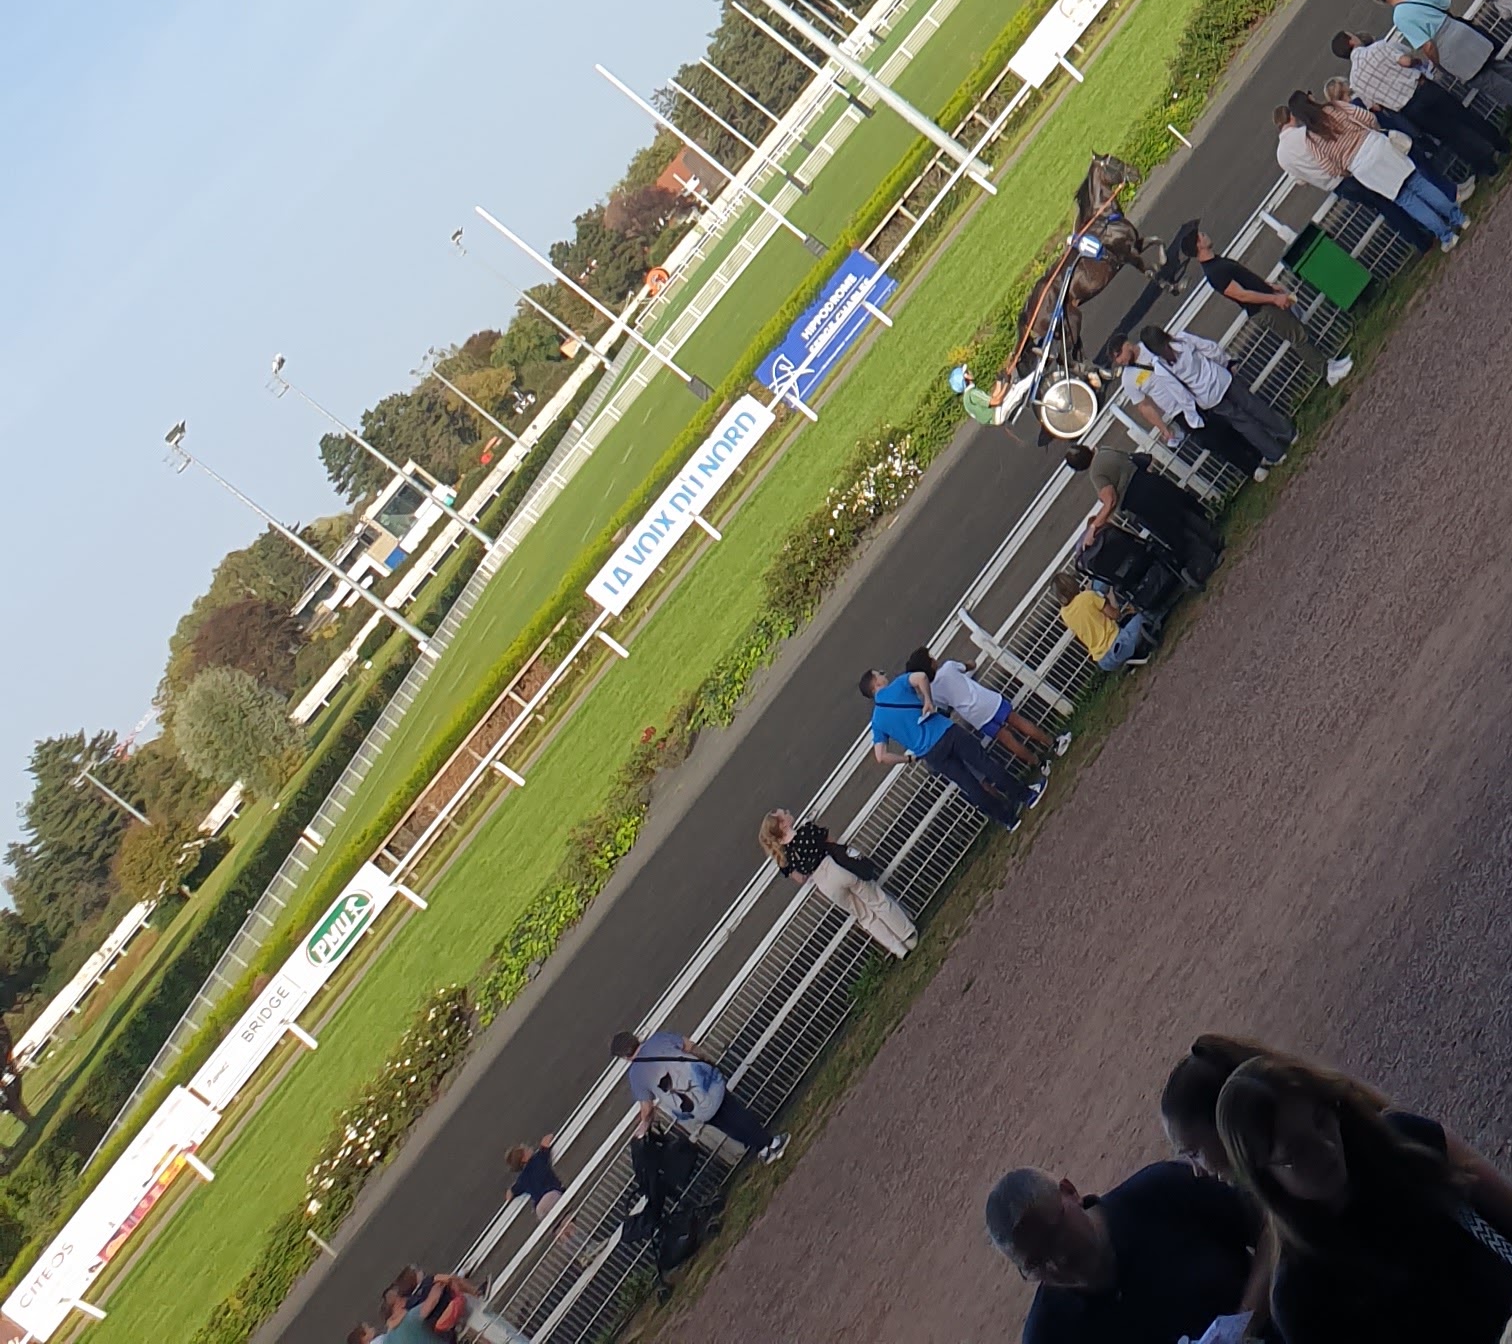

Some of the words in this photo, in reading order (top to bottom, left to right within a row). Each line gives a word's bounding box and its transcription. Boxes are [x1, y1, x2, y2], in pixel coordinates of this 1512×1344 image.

[1080, 236, 1099, 254] 11
[799, 271, 858, 341] HIPPODROME
[624, 508, 677, 568] VOIX
[668, 473, 705, 513] DU
[696, 408, 758, 478] NORD
[309, 910, 354, 961] PMU
[240, 984, 290, 1044] BRIDGE
[20, 1243, 74, 1308] CITEOS
